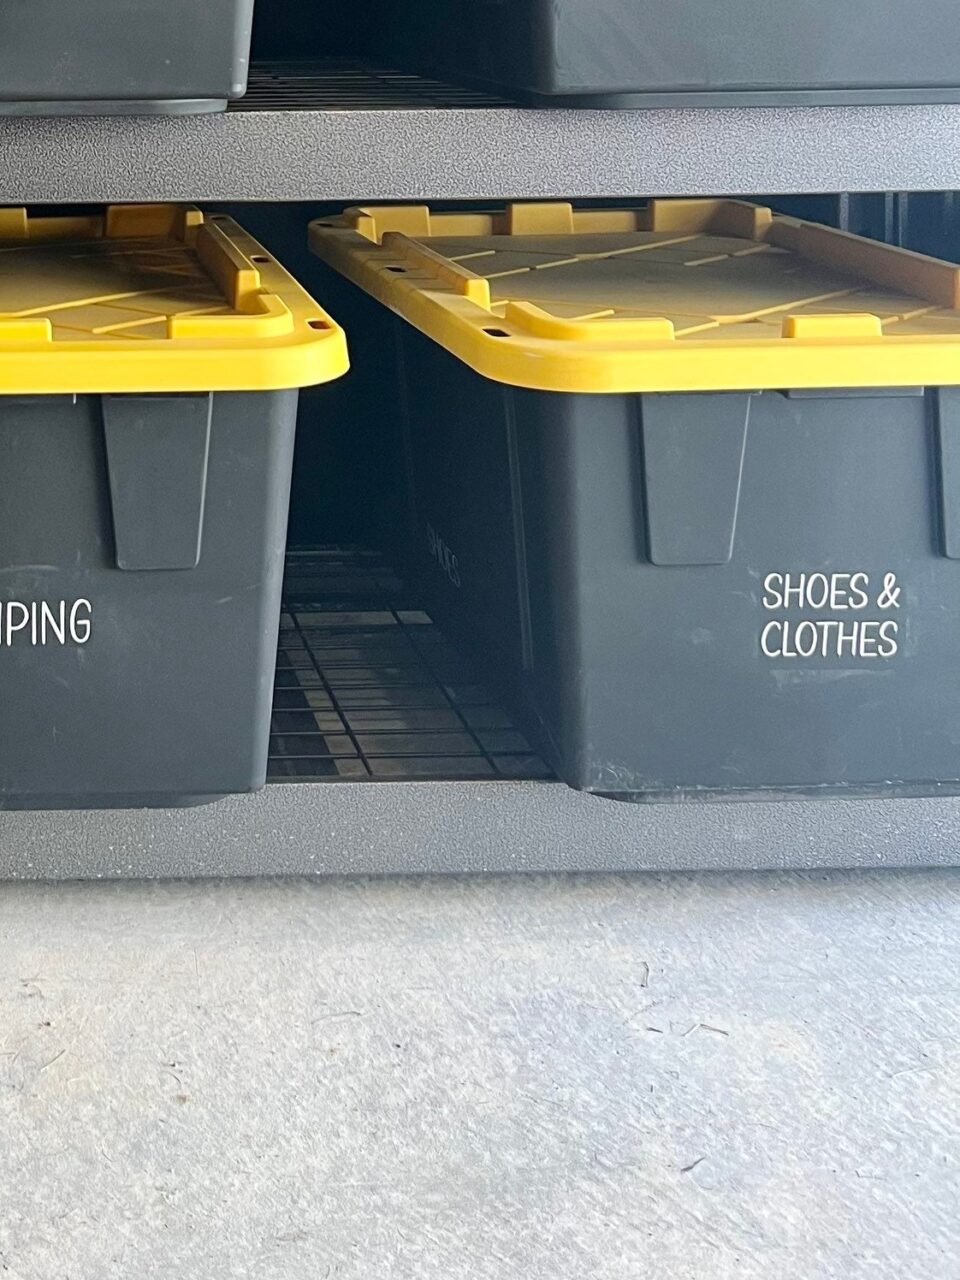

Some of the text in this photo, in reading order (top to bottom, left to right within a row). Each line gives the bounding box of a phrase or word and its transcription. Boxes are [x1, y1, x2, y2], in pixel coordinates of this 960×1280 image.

[762, 572, 901, 610] SHOES &
[760, 620, 899, 658] CLOTHES
